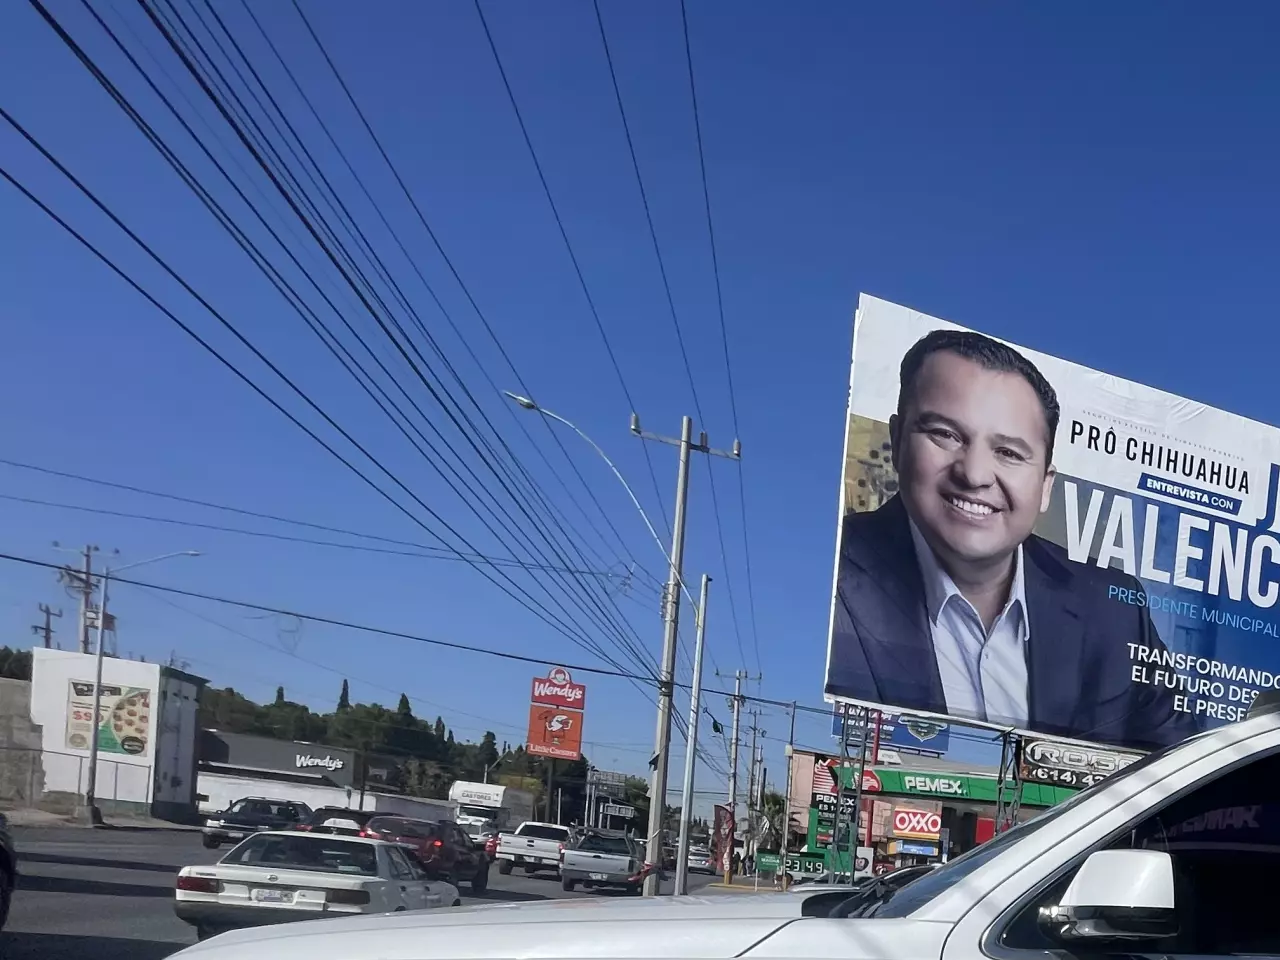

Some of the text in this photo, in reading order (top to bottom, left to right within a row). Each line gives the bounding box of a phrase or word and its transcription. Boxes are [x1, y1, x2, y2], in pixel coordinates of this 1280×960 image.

[1070, 420, 1117, 455] PRÔ
[1126, 437, 1250, 495] CHIHUAHUA
[1146, 478, 1234, 510] ENTREVISTA CON
[1108, 585, 1197, 619] PRESIDENTE
[1201, 608, 1279, 638] MUNICIPAL
[533, 681, 583, 701] Wendy's
[1131, 665, 1150, 684] EL
[1154, 670, 1224, 698] FUTURO
[1173, 695, 1191, 713] EL
[530, 743, 549, 754] Little
[295, 754, 345, 771] Wendy's
[1032, 767, 1076, 784] (614)
[904, 776, 962, 795] PEMEX
[895, 812, 942, 833] OXXO
[785, 859, 823, 873] 23.49
